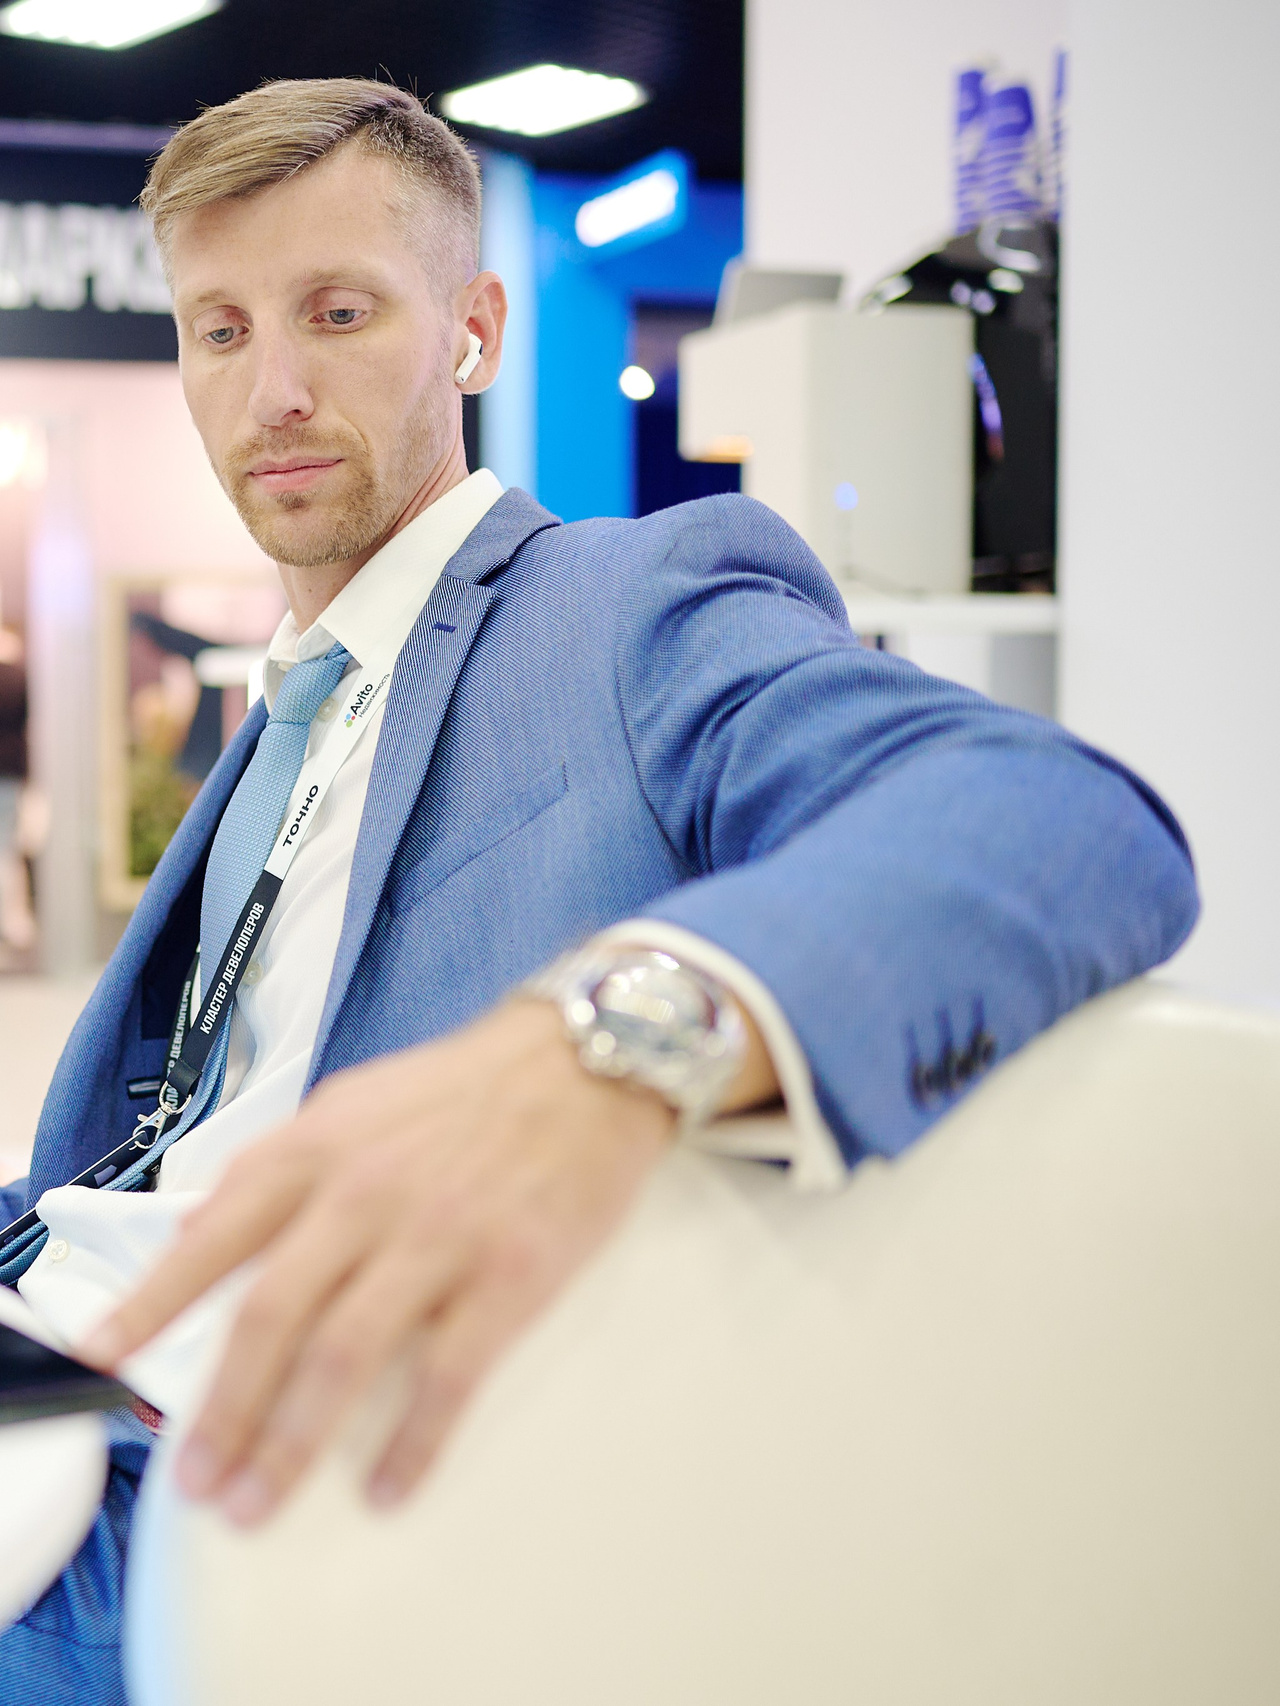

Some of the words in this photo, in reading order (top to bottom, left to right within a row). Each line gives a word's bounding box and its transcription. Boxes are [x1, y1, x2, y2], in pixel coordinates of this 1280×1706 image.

[350, 684, 373, 715] Avito
[358, 673, 391, 718] Недвижимость
[282, 785, 319, 847] ТОЧНО
[200, 981, 228, 1035] КЛАСТЕР
[222, 902, 265, 985] ДЕВЕЛОПЕРОВ
[170, 980, 192, 1060] ДЕВЕЛОПЕРОВ
